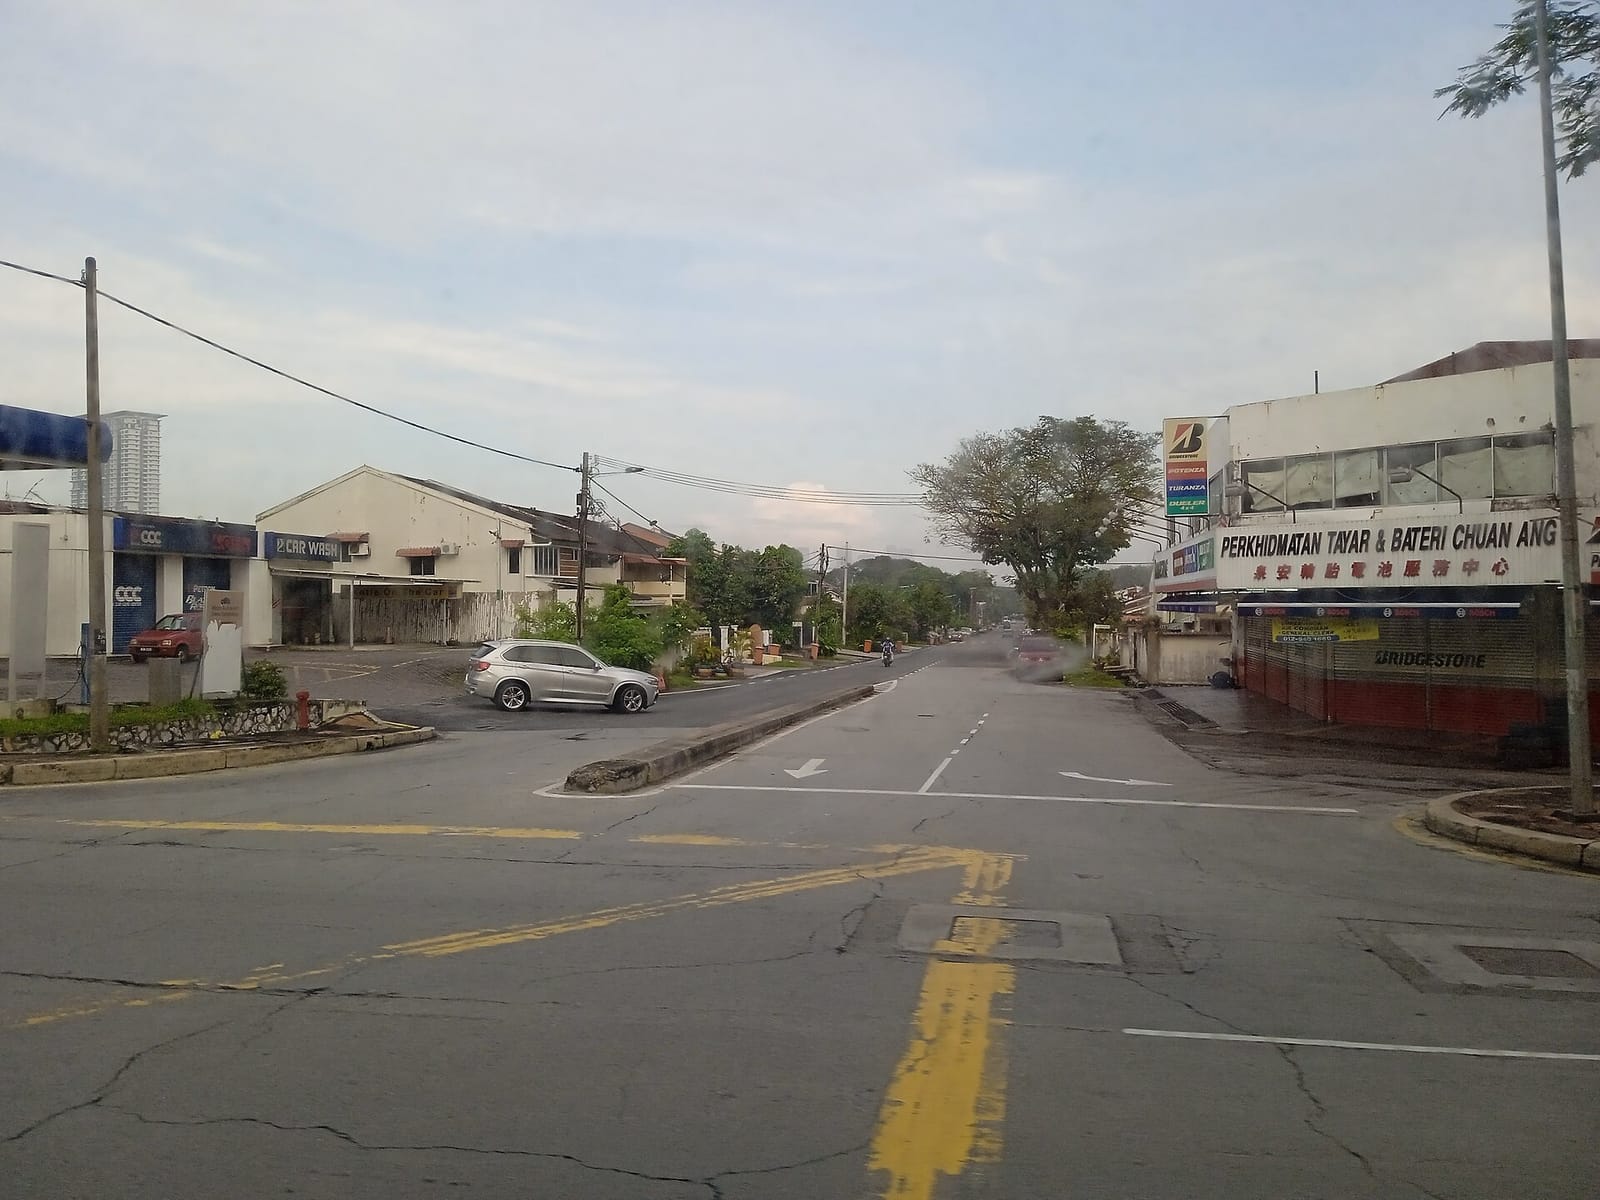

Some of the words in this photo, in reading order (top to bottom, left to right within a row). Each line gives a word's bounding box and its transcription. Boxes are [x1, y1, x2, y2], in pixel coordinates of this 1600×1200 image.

[1168, 484, 1206, 492] TURANZA
[140, 530, 162, 545] CCC
[1220, 531, 1322, 558] PERKHIDMATAN
[1327, 528, 1371, 555] TAYAR
[1375, 528, 1386, 553] &
[1390, 525, 1448, 552] BATERI
[1452, 521, 1512, 550] CHUAN
[1516, 518, 1557, 548] ANG
[286, 538, 306, 554] CAR
[307, 541, 338, 557] WASH
[115, 585, 143, 602] CCC
[1327, 608, 1350, 616] BOSCH
[1395, 609, 1419, 617] BOSCH
[1468, 609, 1496, 617] BOSCH
[1374, 650, 1486, 669] BRIDGESTONE
